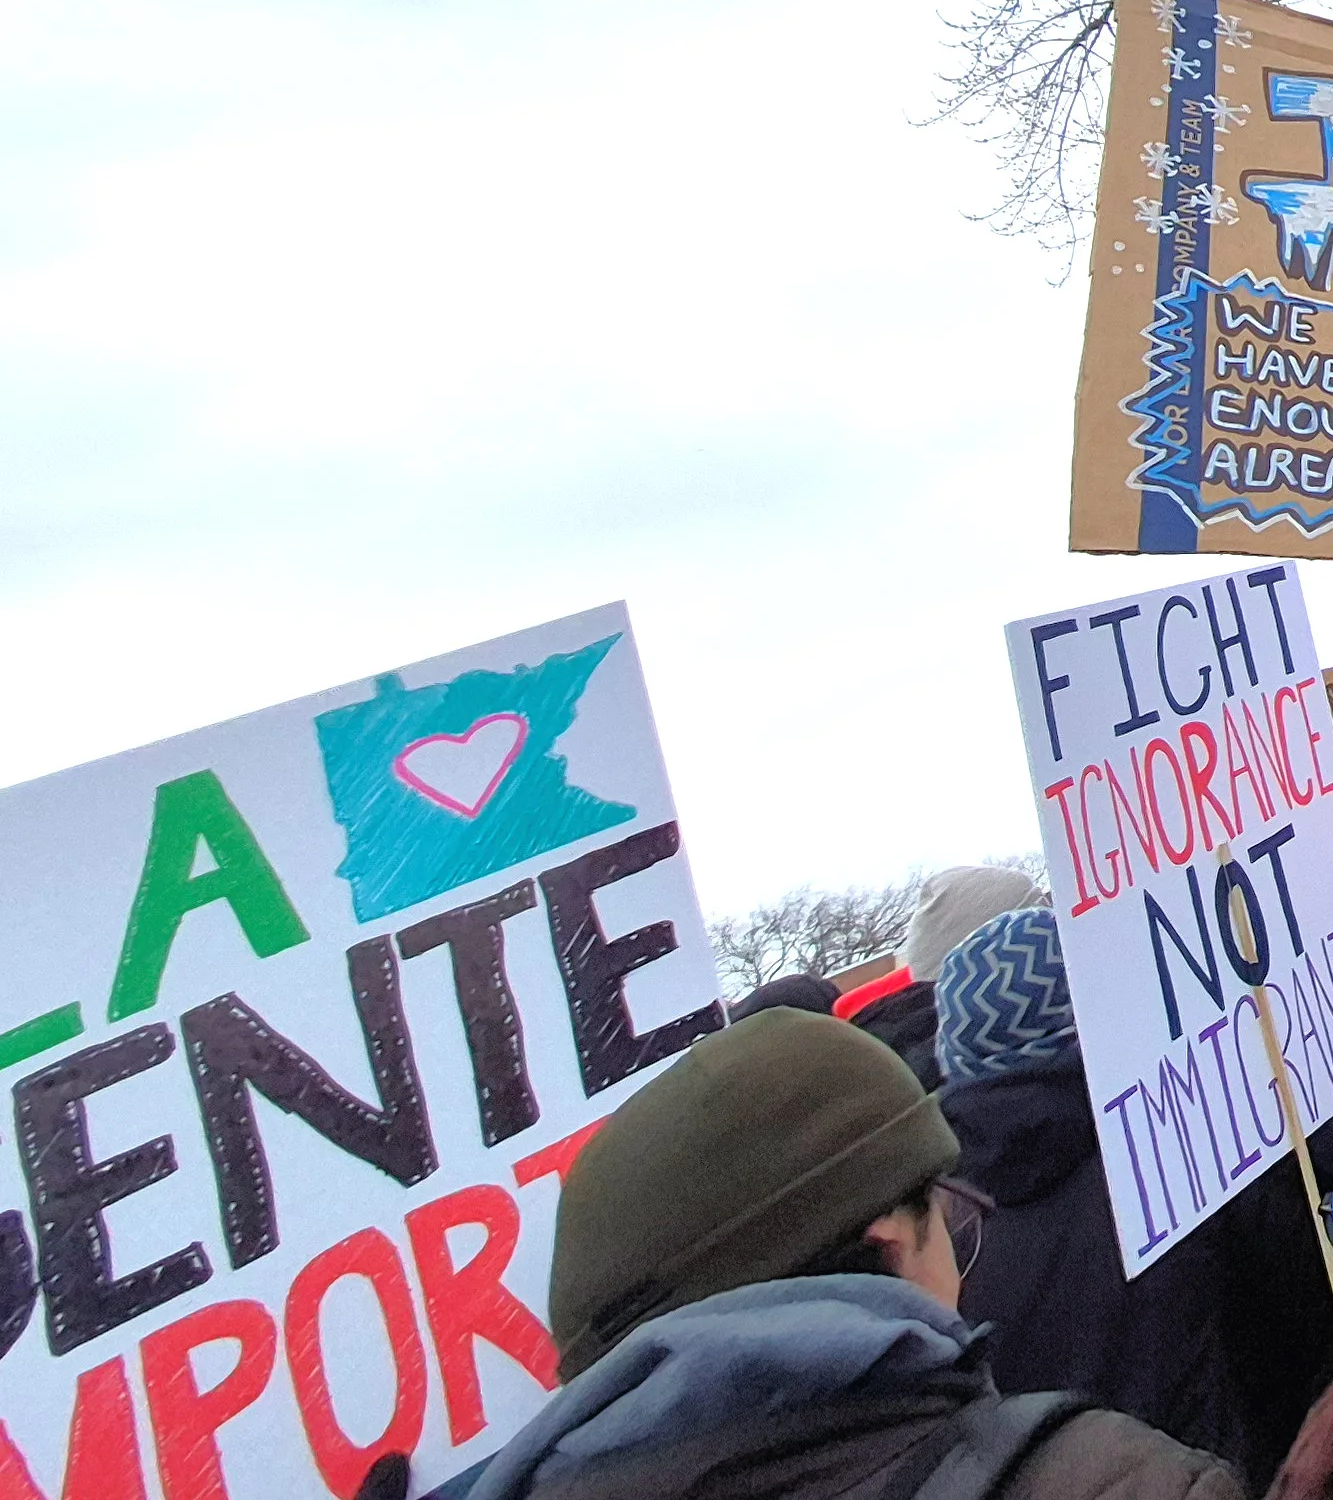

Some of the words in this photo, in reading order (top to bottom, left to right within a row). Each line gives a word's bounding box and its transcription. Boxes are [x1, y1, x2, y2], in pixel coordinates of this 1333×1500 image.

[1180, 100, 1202, 156] TEAM
[1180, 163, 1200, 178] &
[1217, 293, 1319, 347] WE
[1030, 565, 1297, 762] FIGHT
[1142, 824, 1306, 1041] NOT
